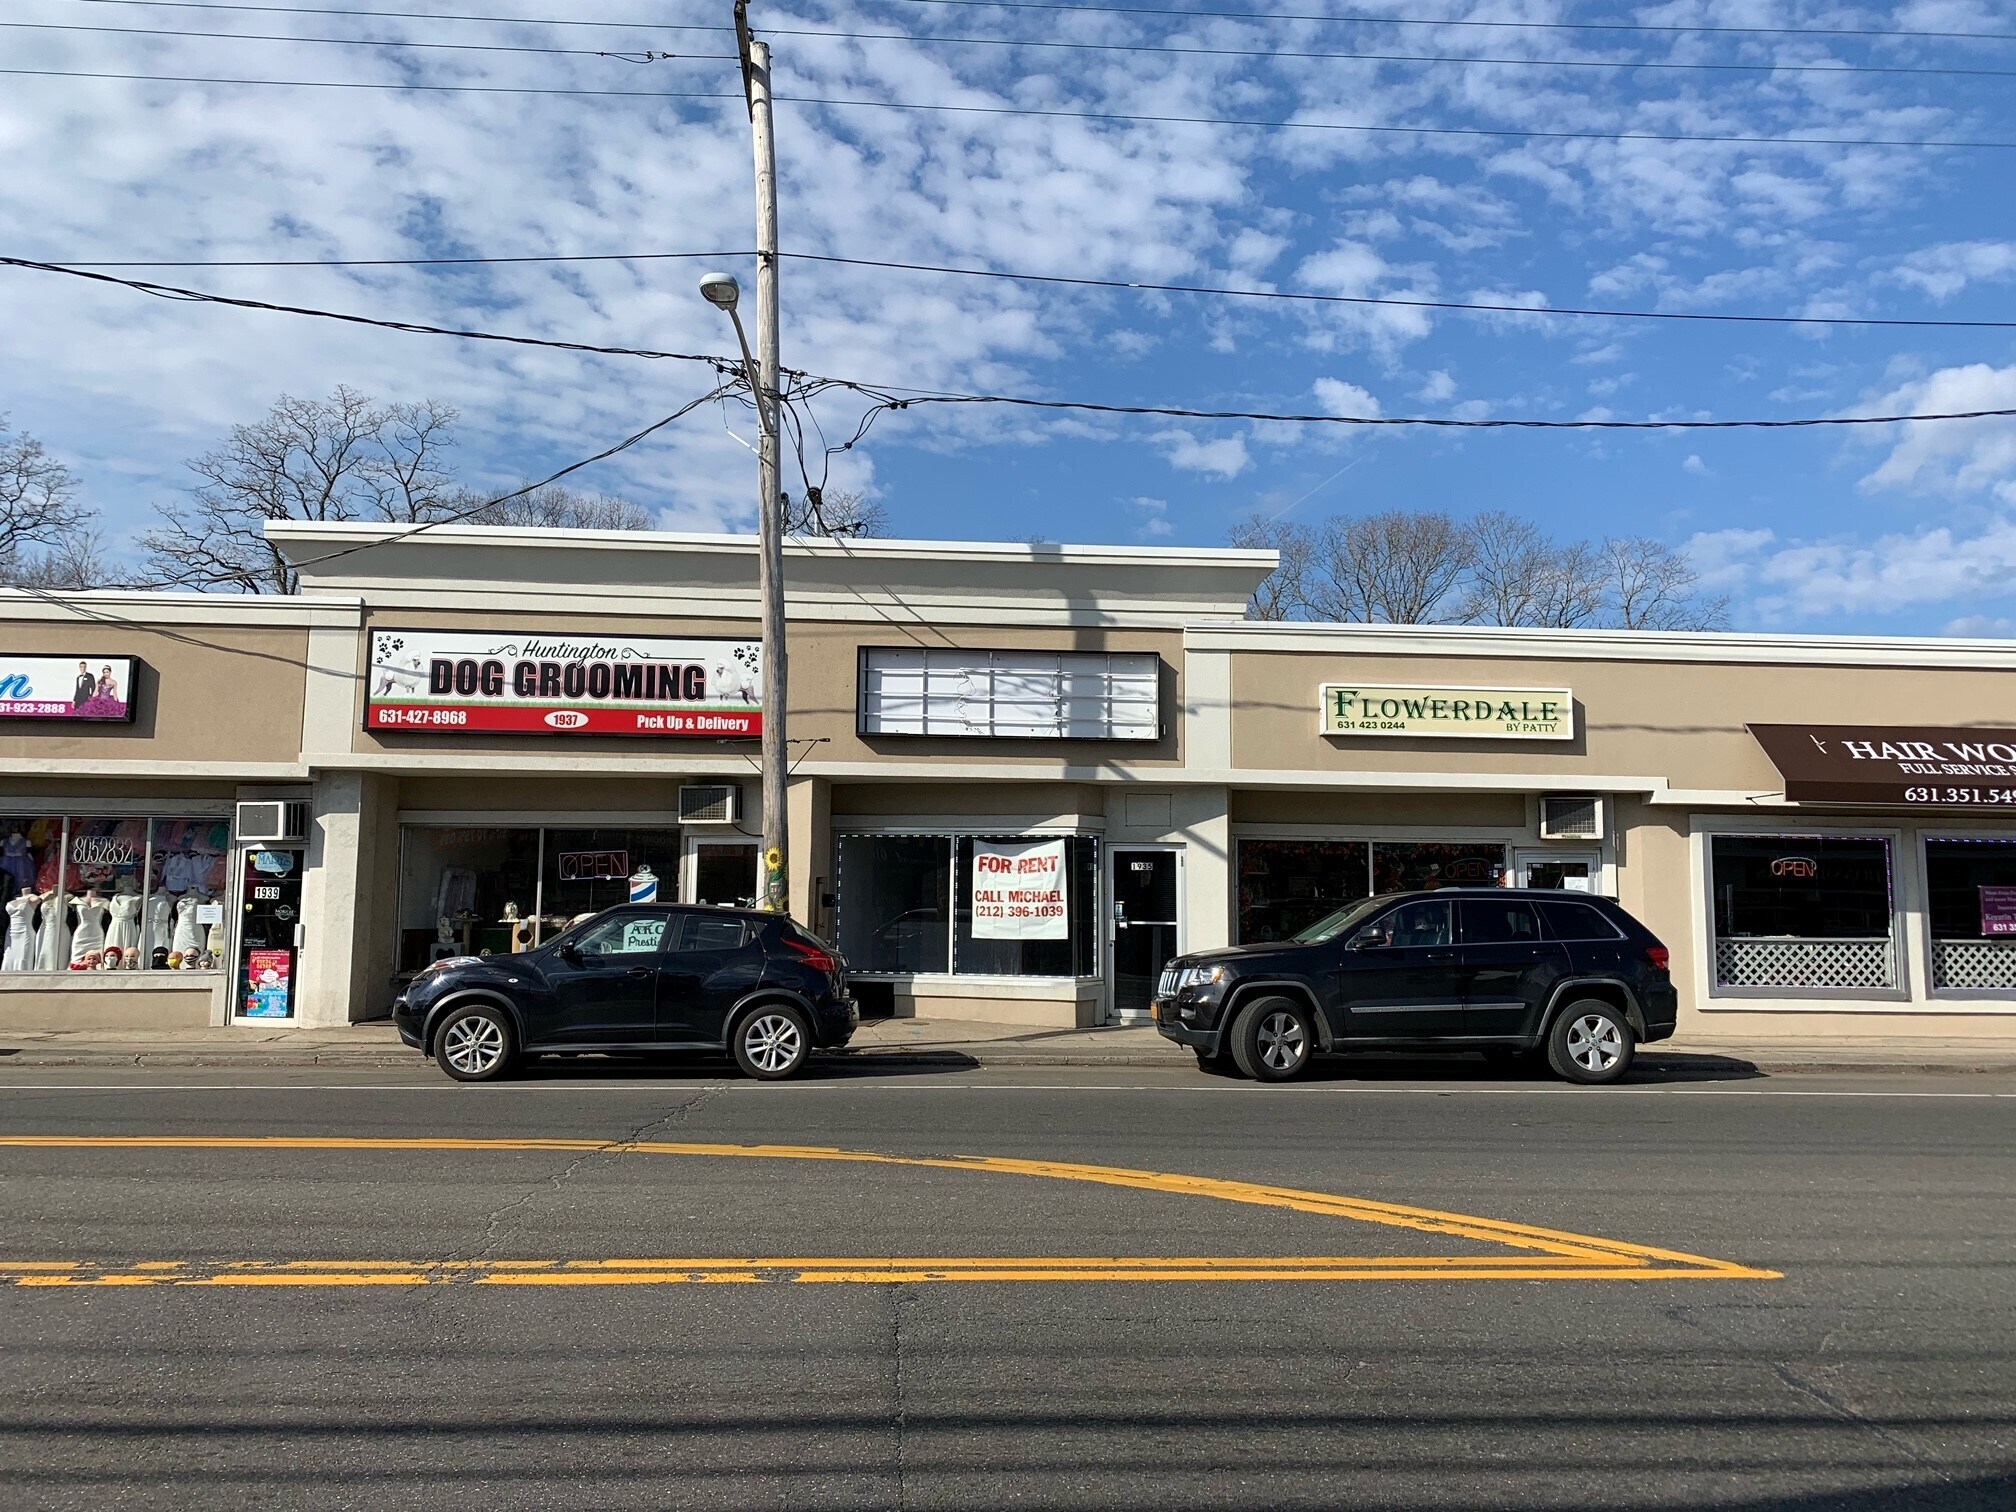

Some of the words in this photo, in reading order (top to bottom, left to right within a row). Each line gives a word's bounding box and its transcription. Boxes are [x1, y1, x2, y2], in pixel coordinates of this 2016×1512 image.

[522, 639, 618, 668] Huntington
[428, 658, 505, 698] DOG
[512, 659, 707, 703] GROOMING
[1333, 690, 1561, 722] FLOWERDALE
[379, 709, 467, 725] 631-427-8968
[553, 714, 578, 726] 1937
[637, 714, 664, 729] Pick
[667, 716, 683, 731] Up
[685, 717, 695, 730] &
[697, 716, 749, 732] Delivery
[1337, 721, 1355, 729] 631
[1359, 721, 1378, 729] 423
[1380, 721, 1406, 729] 0244
[1506, 722, 1521, 732] BY
[1523, 723, 1557, 732] PATTY
[1841, 741, 1949, 761] HAIR
[1942, 742, 2016, 763] WO
[1897, 763, 1943, 775] FULL
[1940, 764, 2011, 776] SERVICE
[73, 836, 133, 863] 8052832
[562, 853, 626, 878] OPEN
[978, 856, 1012, 873] FOR
[1017, 855, 1058, 874] RENT
[1445, 863, 1488, 879] OPEN
[1771, 861, 1814, 877] OPEN
[257, 888, 279, 898] 1939
[975, 890, 1004, 902] CALL
[1008, 890, 1064, 903] MICHAEL
[975, 905, 1003, 918] (212)
[1007, 906, 1063, 918] 396-1039
[1993, 923, 2007, 931] 631
